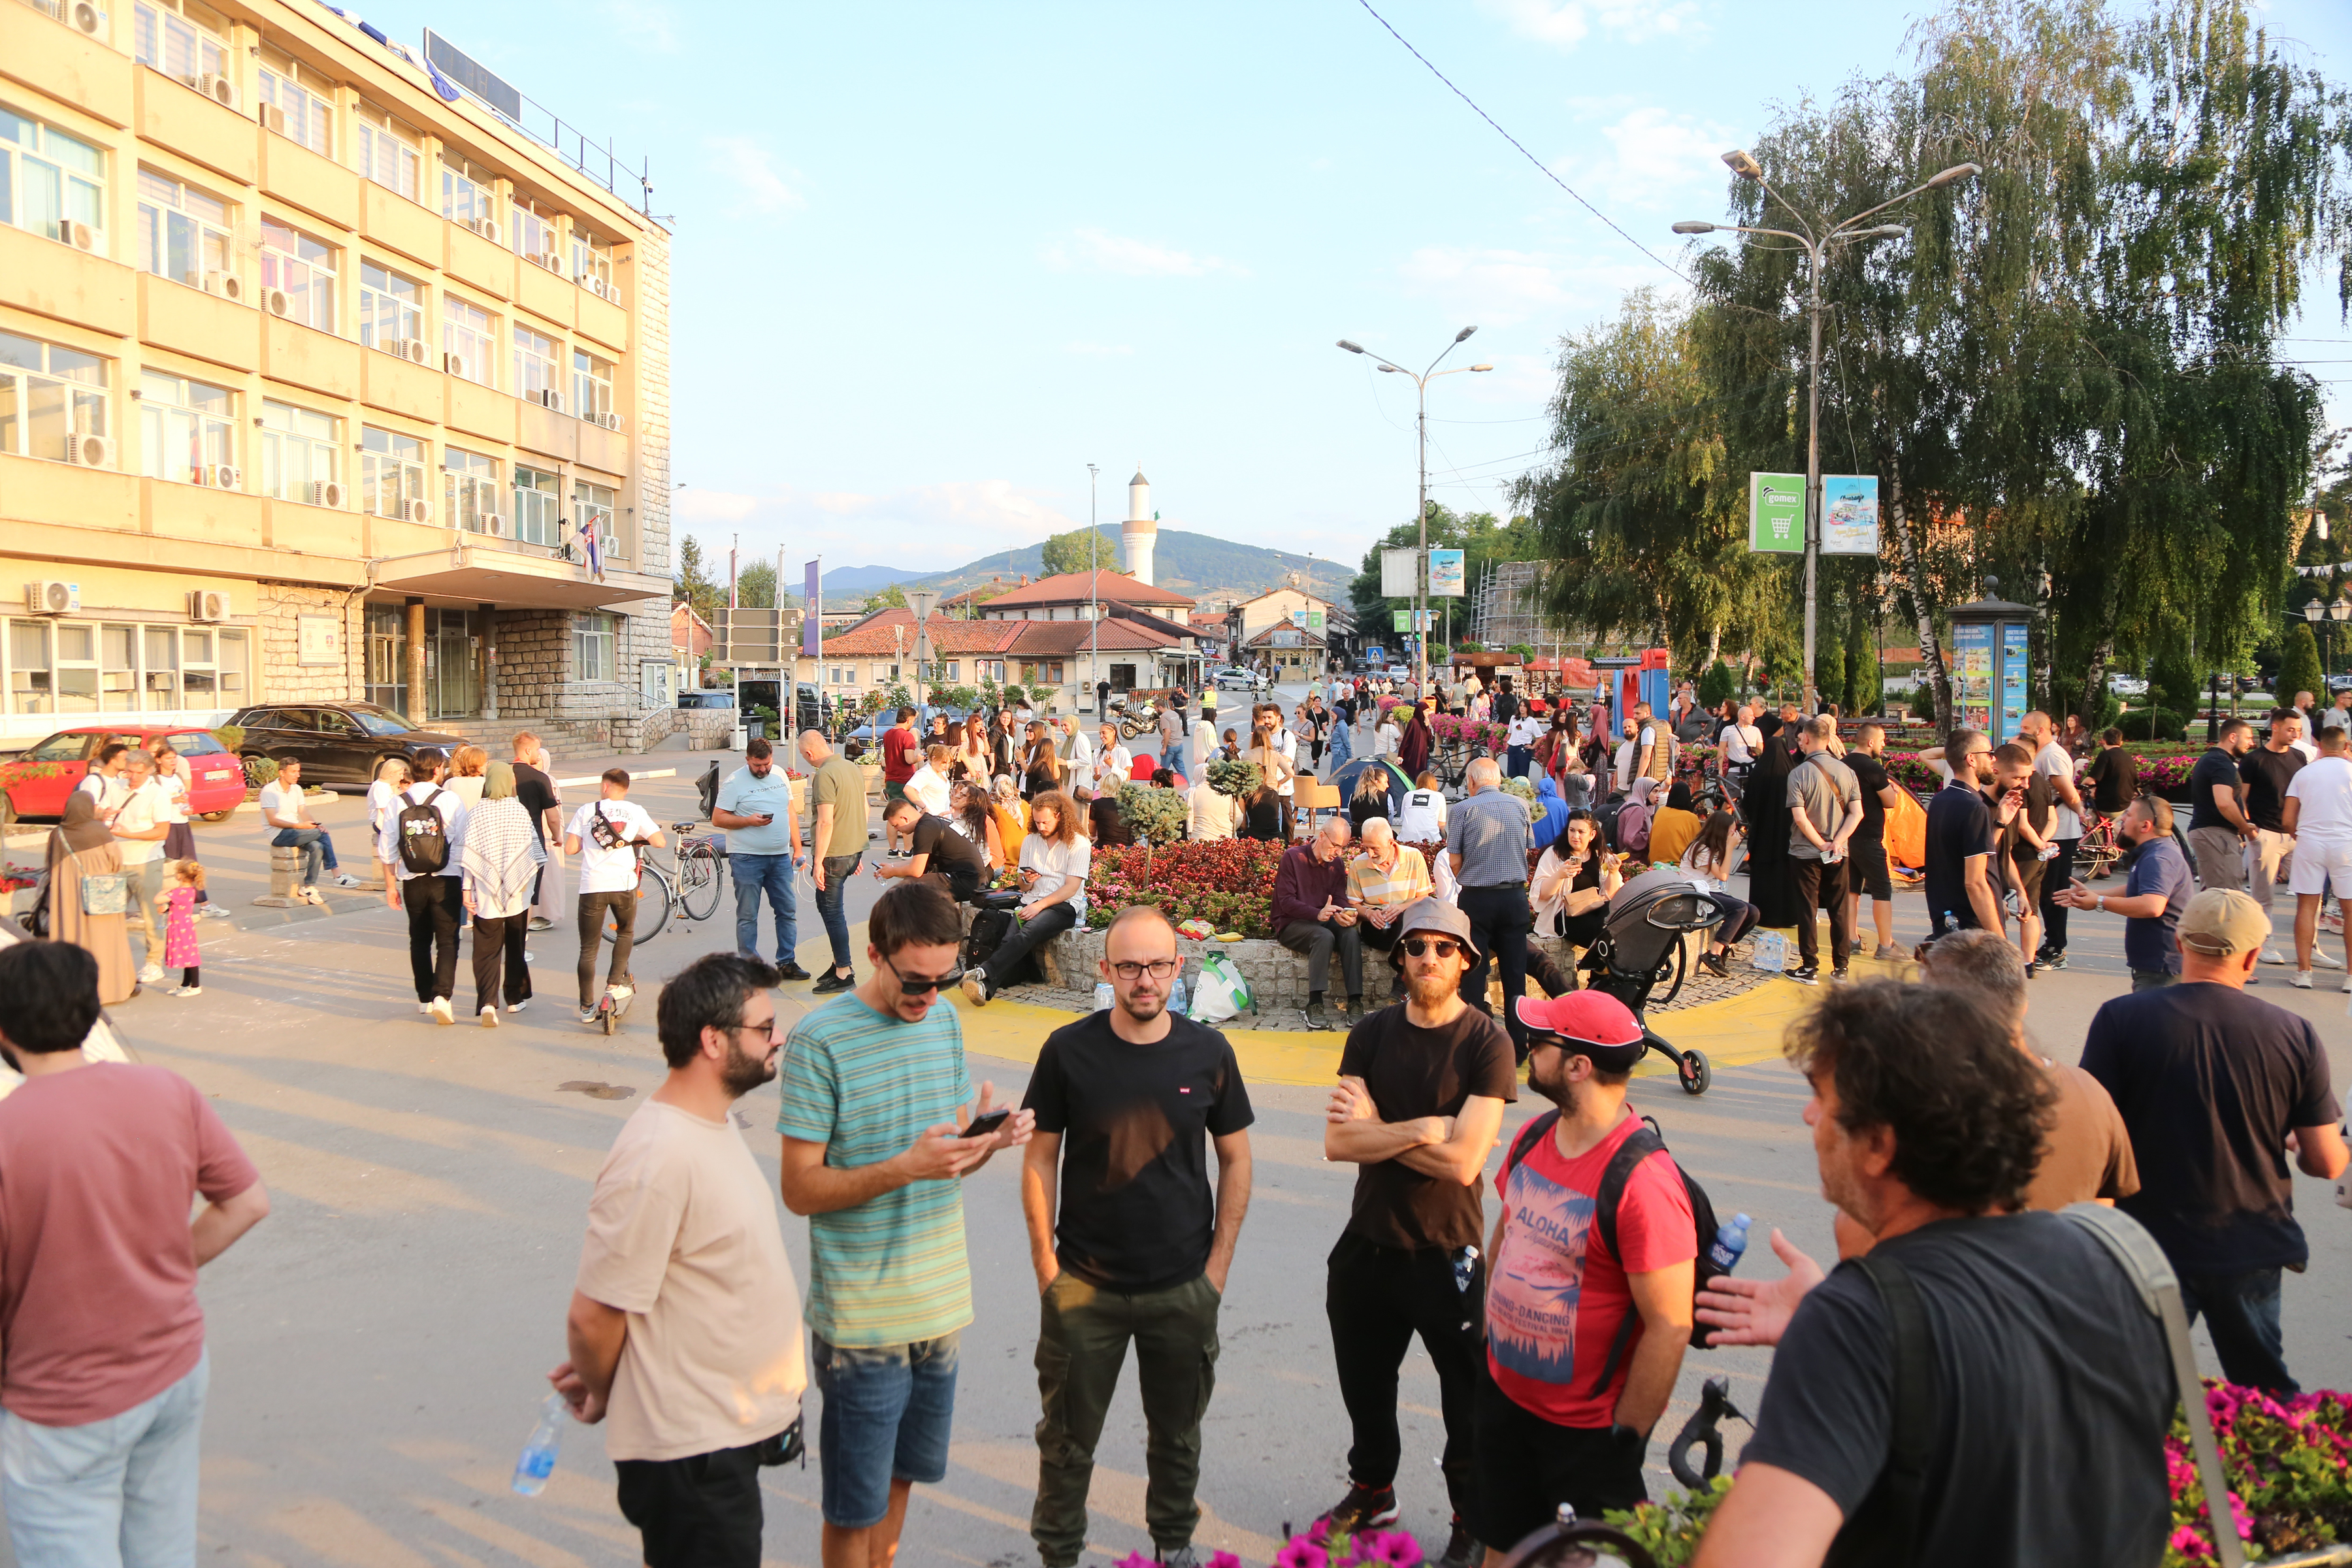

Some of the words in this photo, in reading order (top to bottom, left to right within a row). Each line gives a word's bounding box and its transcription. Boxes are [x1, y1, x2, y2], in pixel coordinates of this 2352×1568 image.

[1769, 494, 1797, 504] gomex
[1516, 1206, 1569, 1247] ALOHA
[1514, 1316, 1547, 1333] FESTIVAL
